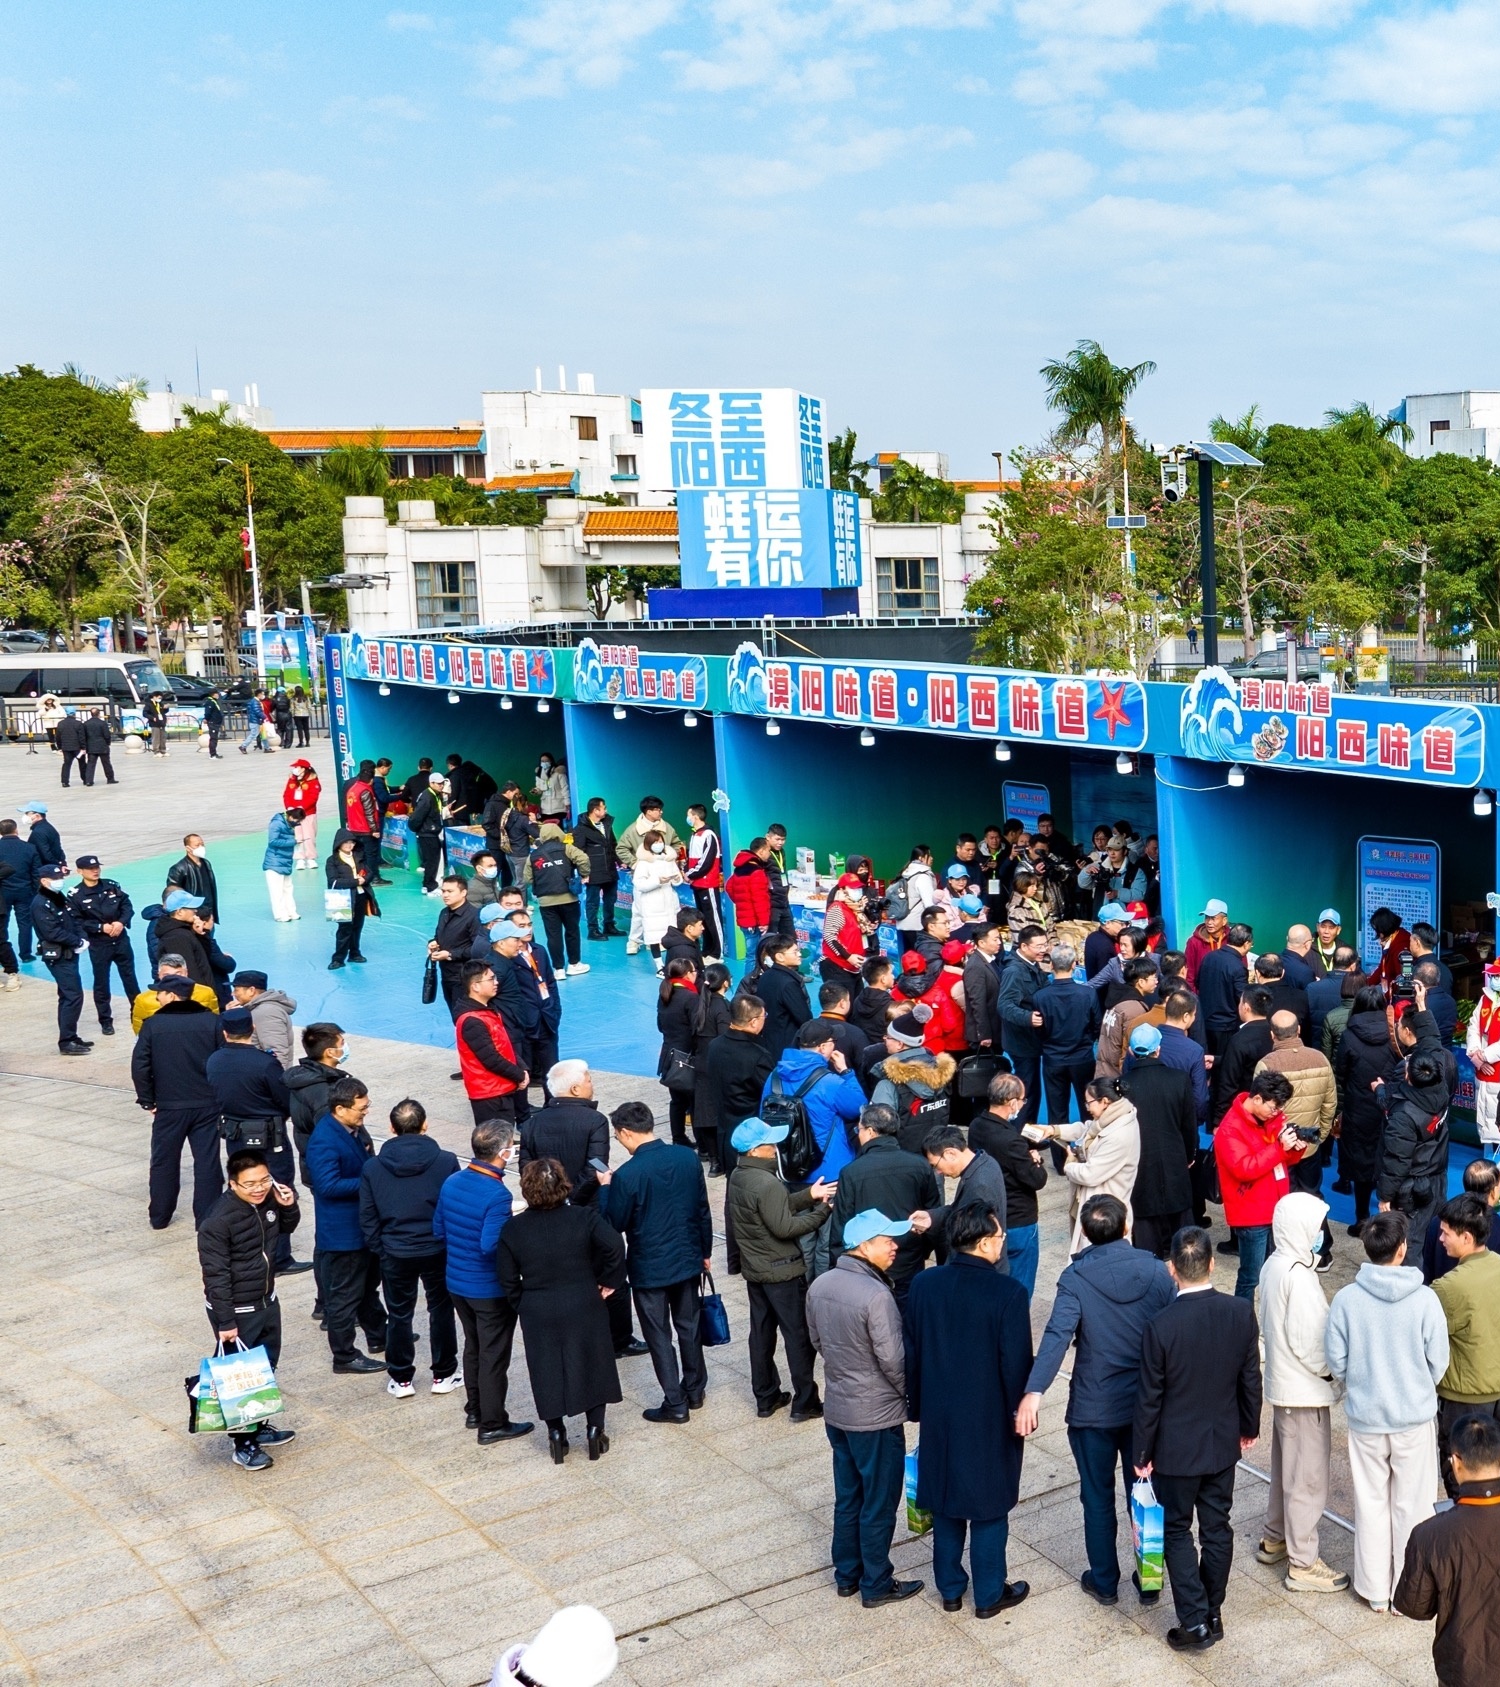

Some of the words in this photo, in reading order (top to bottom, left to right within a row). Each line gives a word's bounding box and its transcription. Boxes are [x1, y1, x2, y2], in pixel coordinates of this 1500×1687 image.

[668, 392, 765, 439] 冬至
[798, 394, 822, 445] 冬至
[670, 441, 766, 488] 阳西
[800, 442, 825, 489] 阳西
[703, 491, 802, 539] 蚝运
[706, 538, 804, 587] 有你
[835, 538, 858, 586] 有你
[600, 646, 638, 668] 漠阳味道
[625, 669, 696, 701] 阳西味道
[1241, 680, 1331, 715] 漠阳味道
[1297, 718, 1456, 773] 阳西味道
